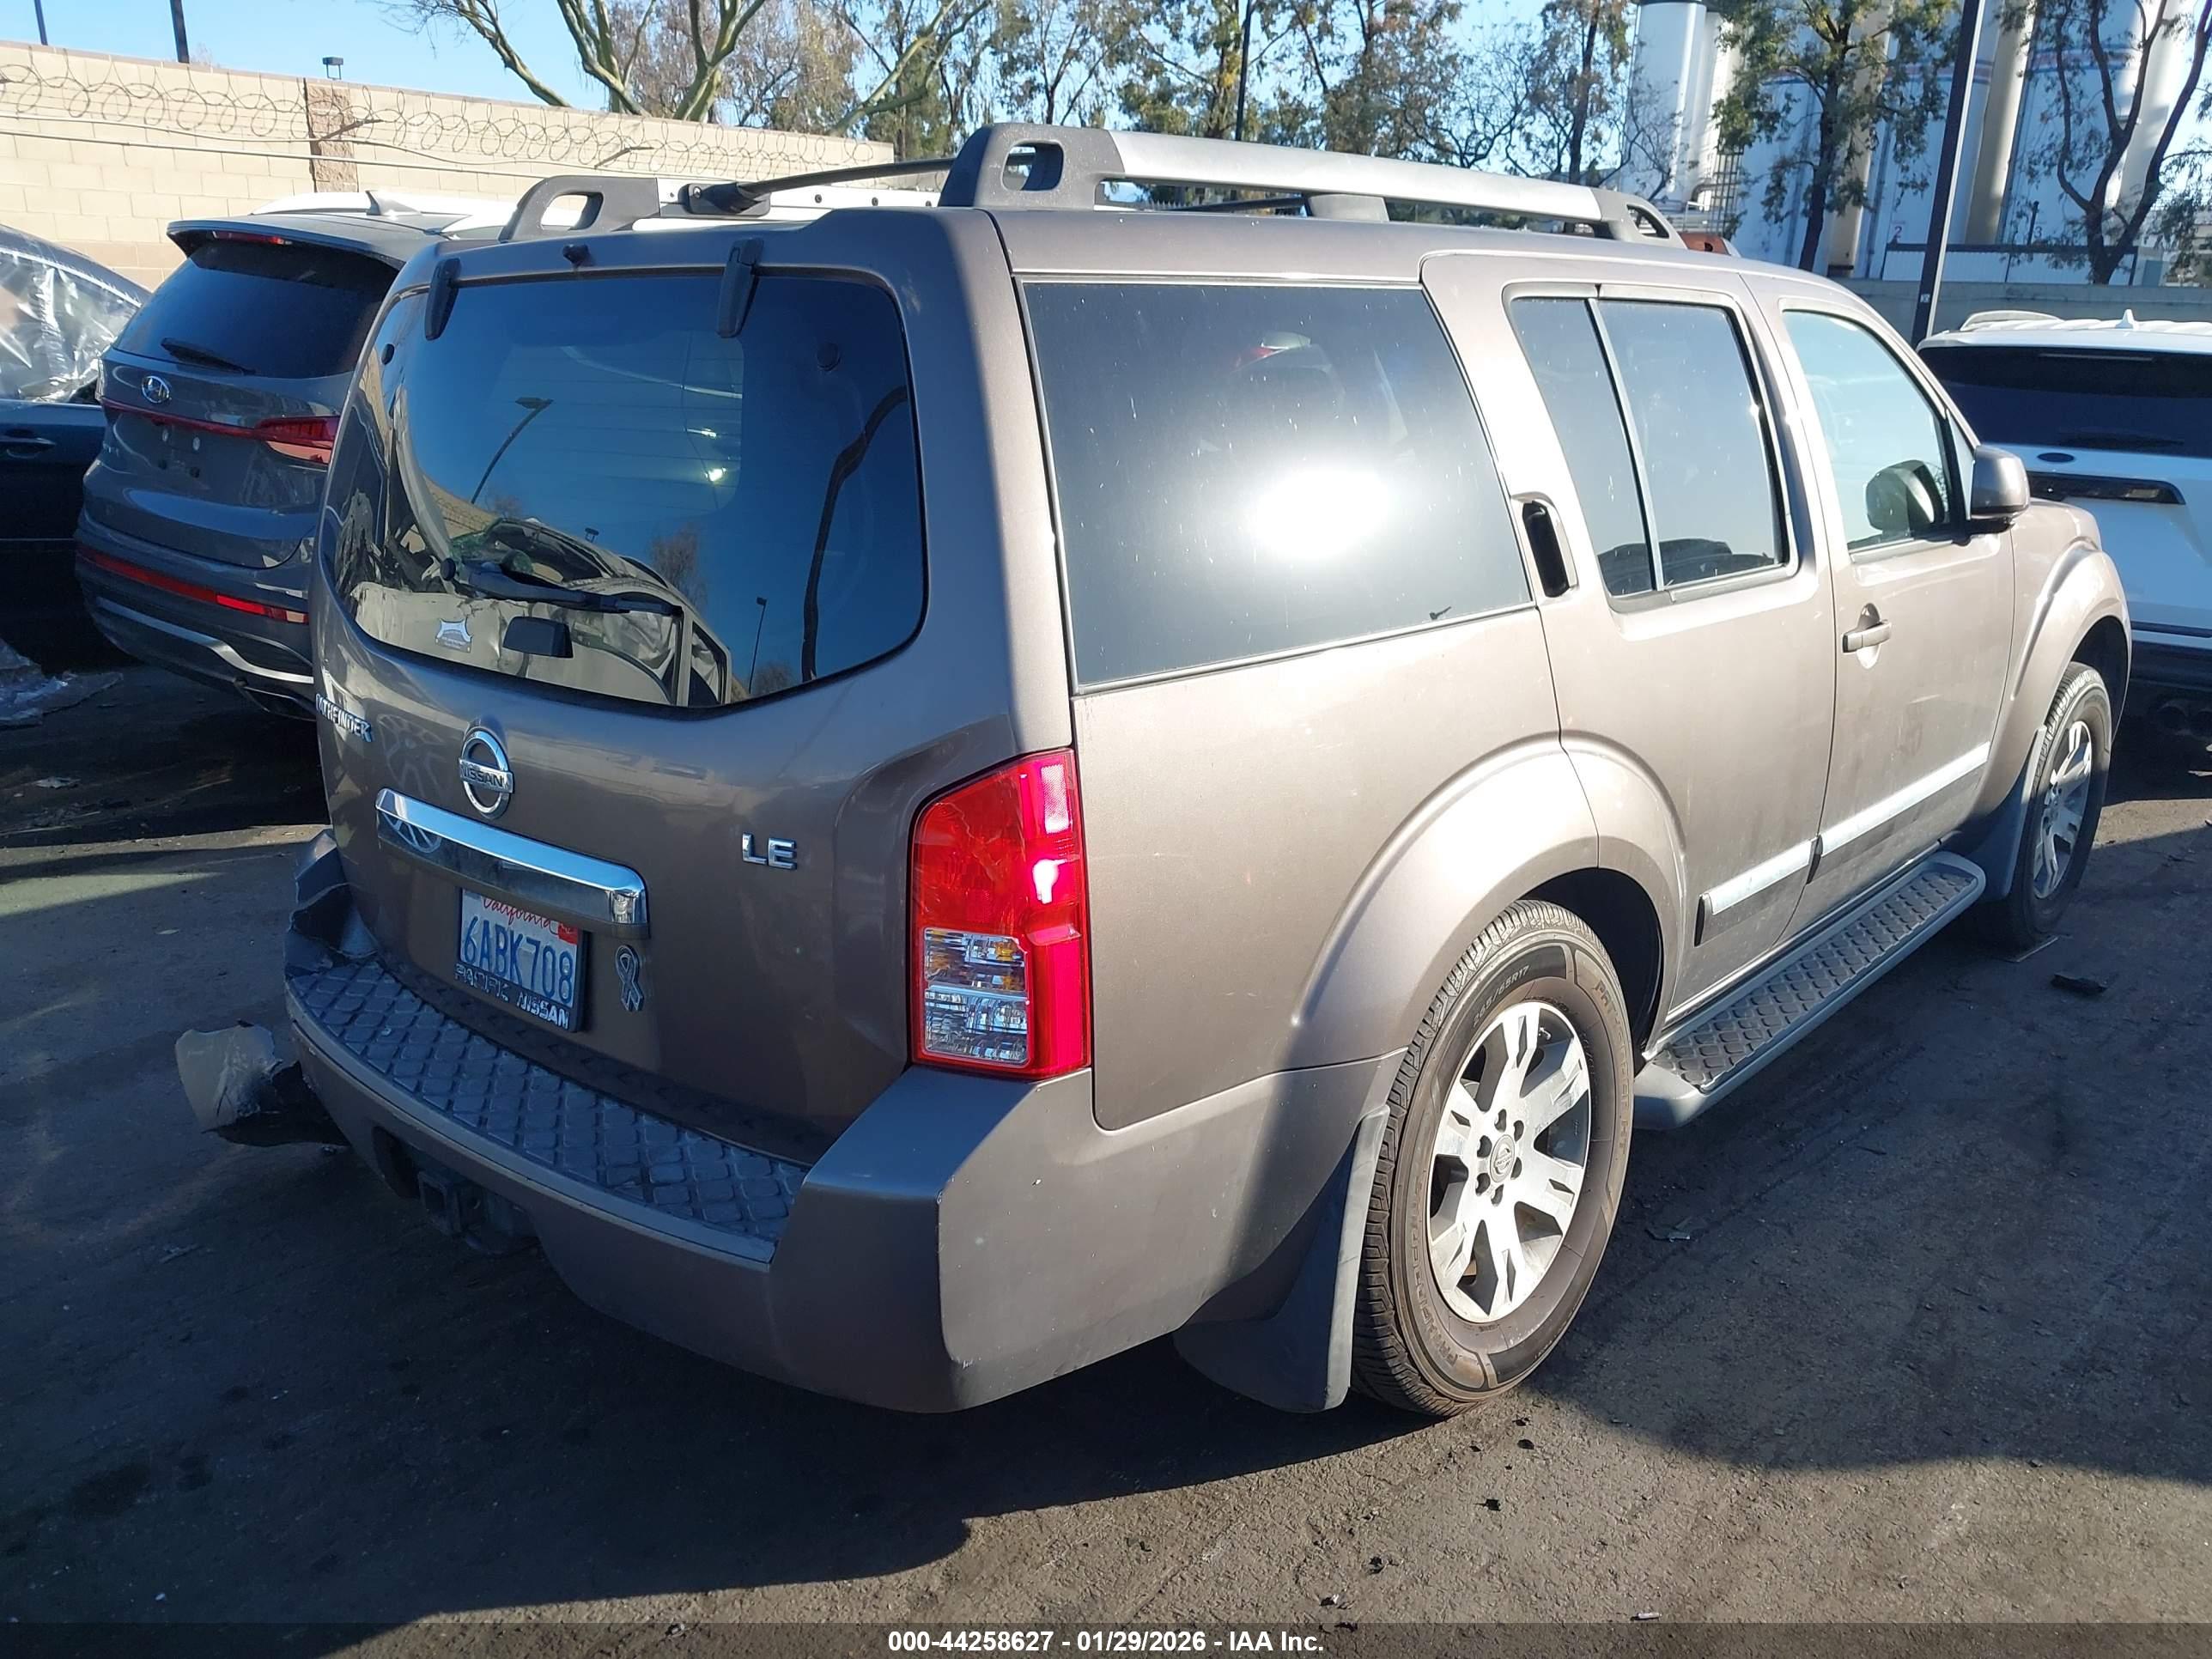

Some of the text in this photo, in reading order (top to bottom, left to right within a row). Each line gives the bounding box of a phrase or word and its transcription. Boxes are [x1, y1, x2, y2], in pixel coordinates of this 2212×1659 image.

[315, 693, 372, 742] PATHFINDER
[460, 761, 506, 788] NISSAN
[741, 830, 798, 870] LE
[463, 915, 574, 1003] 6ABK708
[516, 990, 570, 1030] NISSAN
